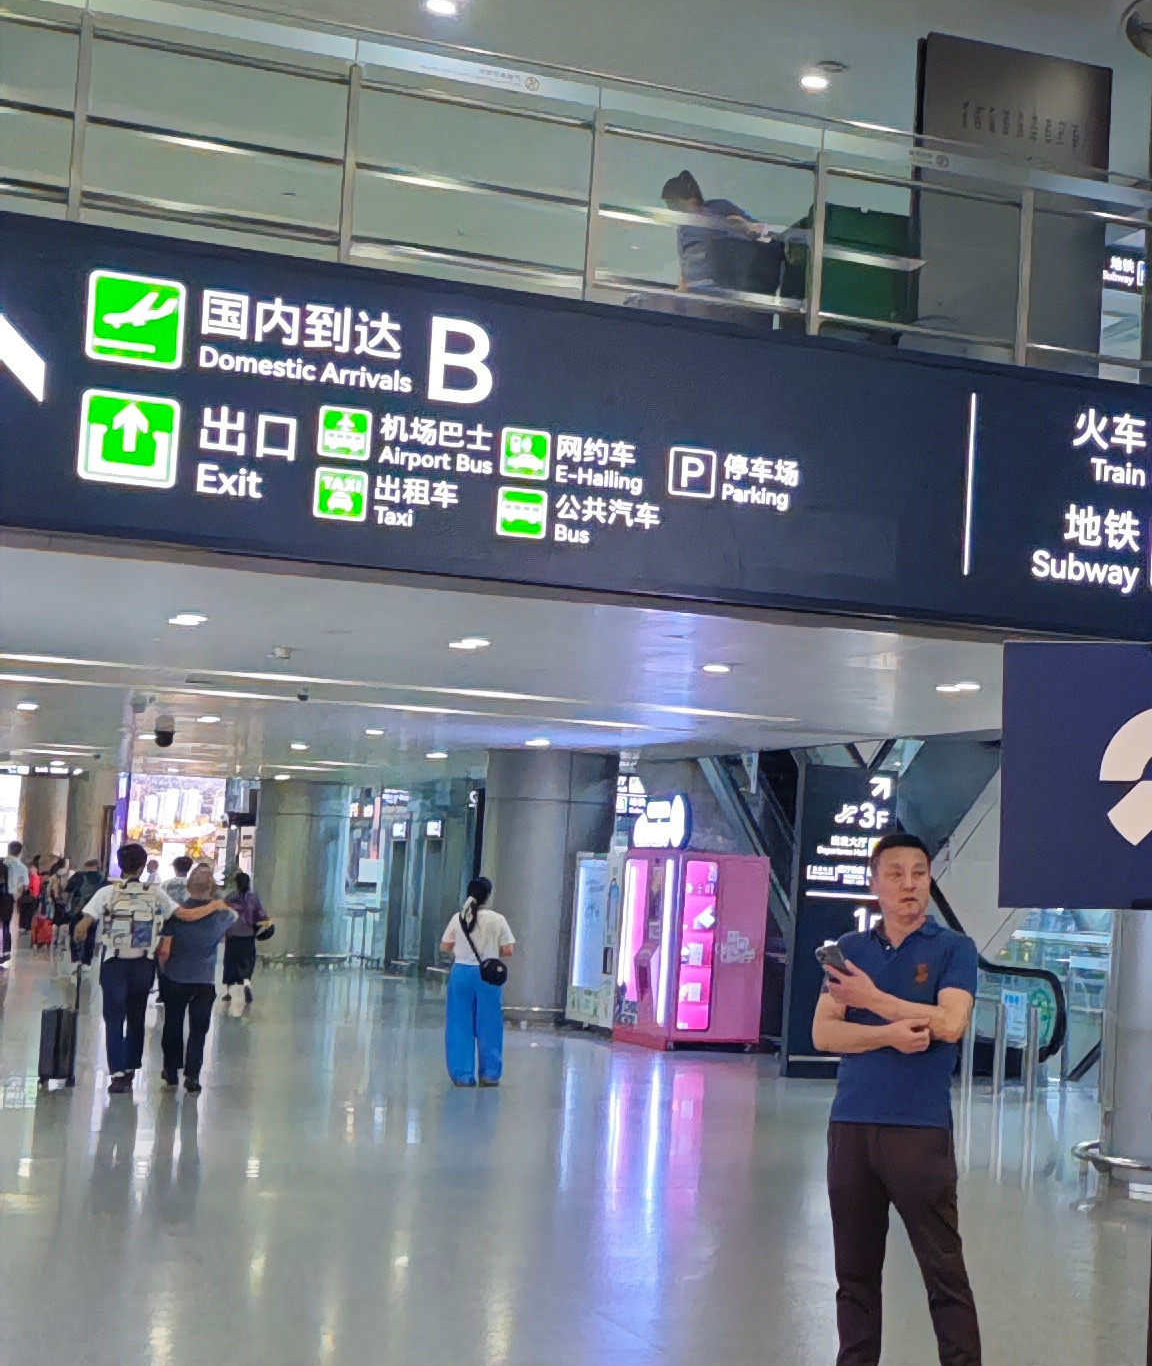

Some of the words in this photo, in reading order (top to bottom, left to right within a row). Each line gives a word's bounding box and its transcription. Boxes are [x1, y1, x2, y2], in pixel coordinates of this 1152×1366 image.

[1110, 256, 1134, 273] 地铁
[201, 288, 401, 359] 国内到达
[199, 346, 316, 381] Domestic
[320, 362, 412, 393] Arrivals
[427, 316, 493, 404] B
[199, 406, 297, 461] 出口
[379, 413, 493, 451] 机场巴士
[1073, 409, 1147, 454] 火车
[378, 446, 452, 471] Airport
[456, 454, 493, 475] Bus
[556, 435, 637, 468] 网约车
[196, 463, 263, 499] Exit
[321, 475, 362, 492] TAXI
[555, 465, 643, 495] E-Hailing
[681, 456, 705, 487] P
[723, 454, 800, 487] 停车场
[1091, 458, 1146, 487] Train
[374, 475, 458, 508] 出租车
[722, 483, 790, 511] Parking
[373, 506, 413, 527] Taxi
[555, 494, 661, 529] 公共汽车
[1064, 504, 1140, 552] 地铁
[554, 524, 590, 543] Bus
[1031, 550, 1140, 595] Subway
[858, 802, 890, 829] 3F
